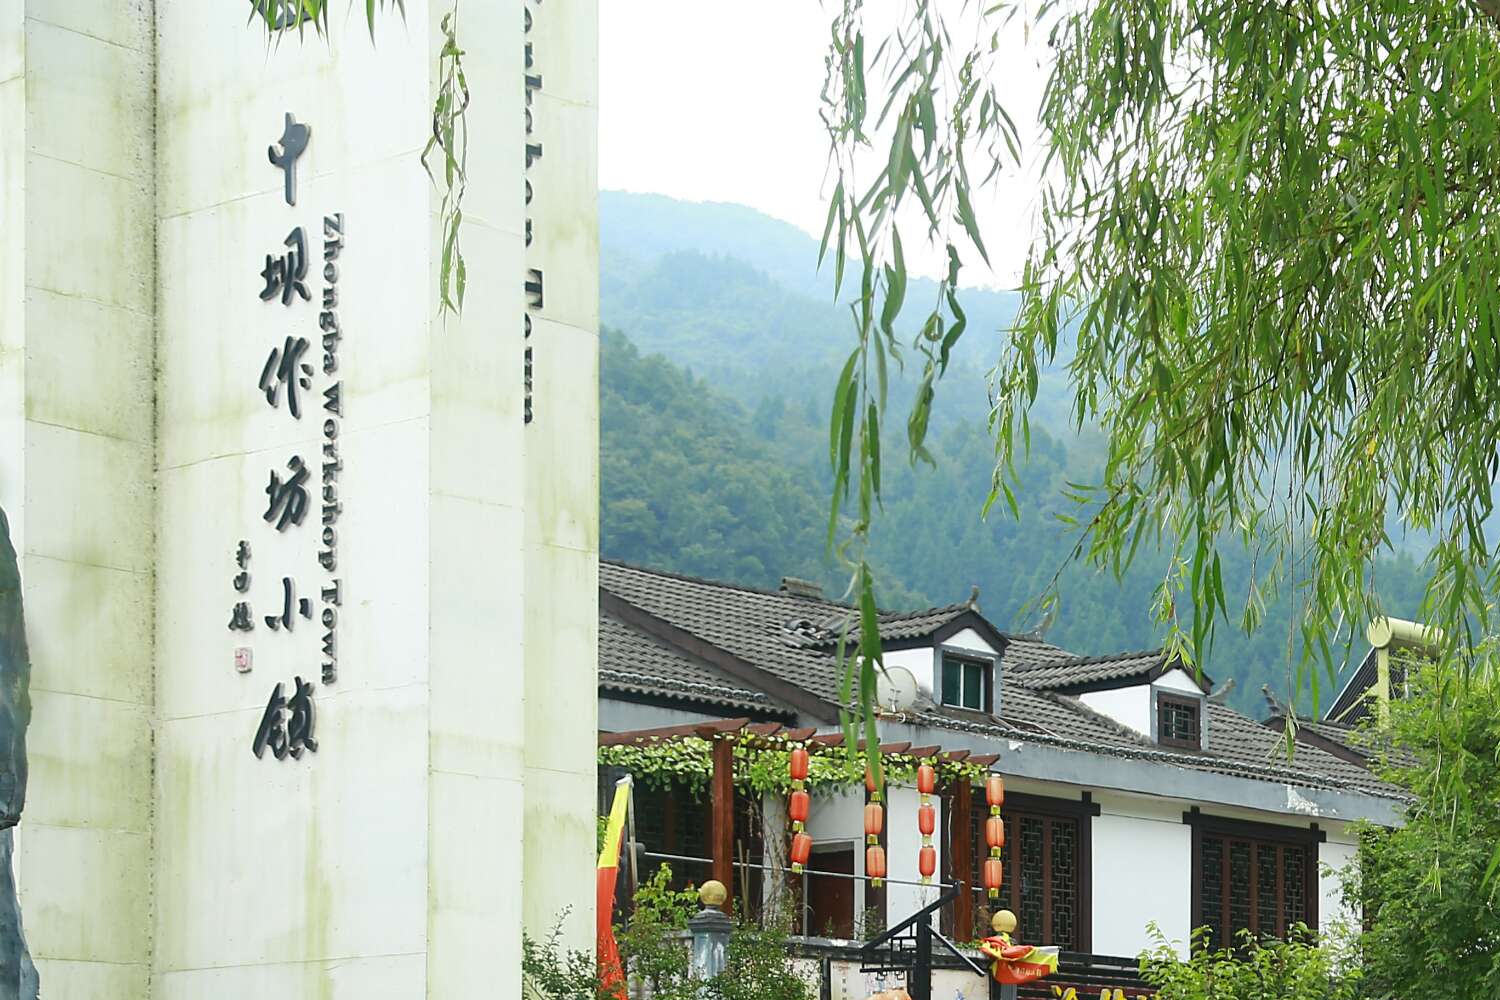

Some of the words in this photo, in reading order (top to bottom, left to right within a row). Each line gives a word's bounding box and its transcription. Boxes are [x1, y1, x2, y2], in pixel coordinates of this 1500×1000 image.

[319, 213, 345, 375] Zhongba
[252, 112, 318, 760] 中坝作坊小镇
[318, 380, 344, 573] Workshop
[321, 579, 344, 685] Town
